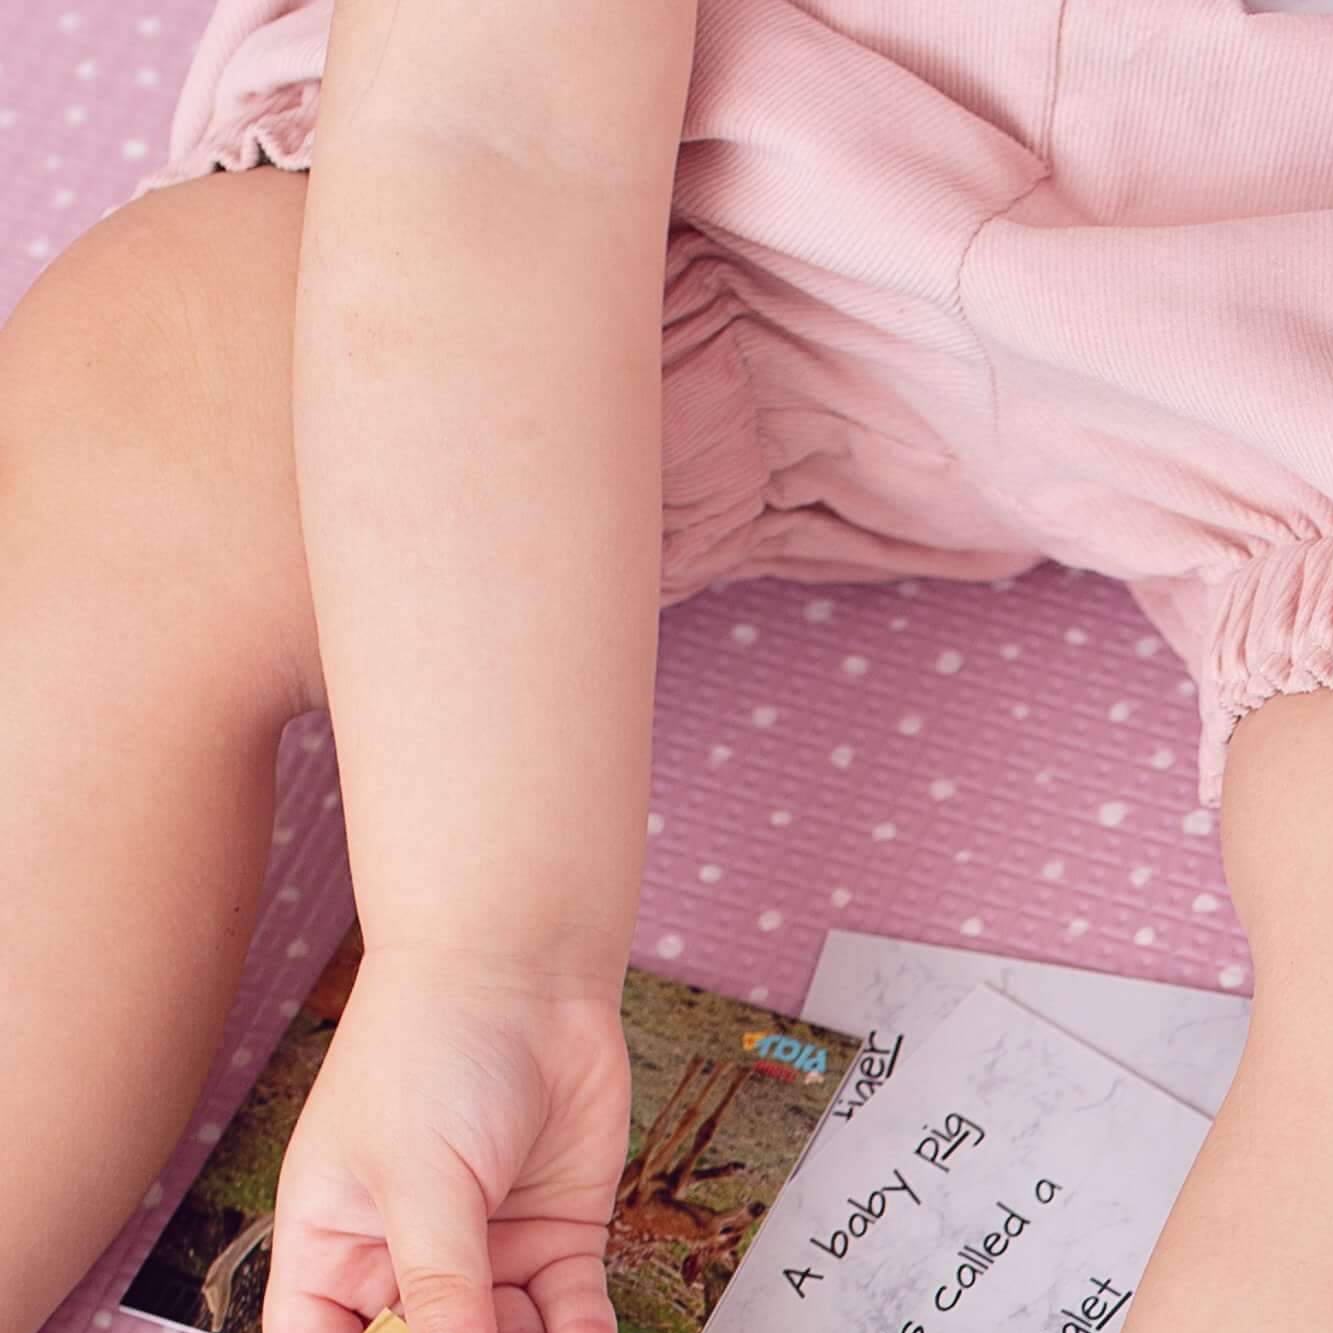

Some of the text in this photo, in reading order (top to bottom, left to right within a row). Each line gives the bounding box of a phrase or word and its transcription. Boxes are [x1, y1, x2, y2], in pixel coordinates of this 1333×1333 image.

[782, 1112, 985, 1298] A baby pig
[935, 1202, 1030, 1312] called
[1035, 1177, 1062, 1204] a
